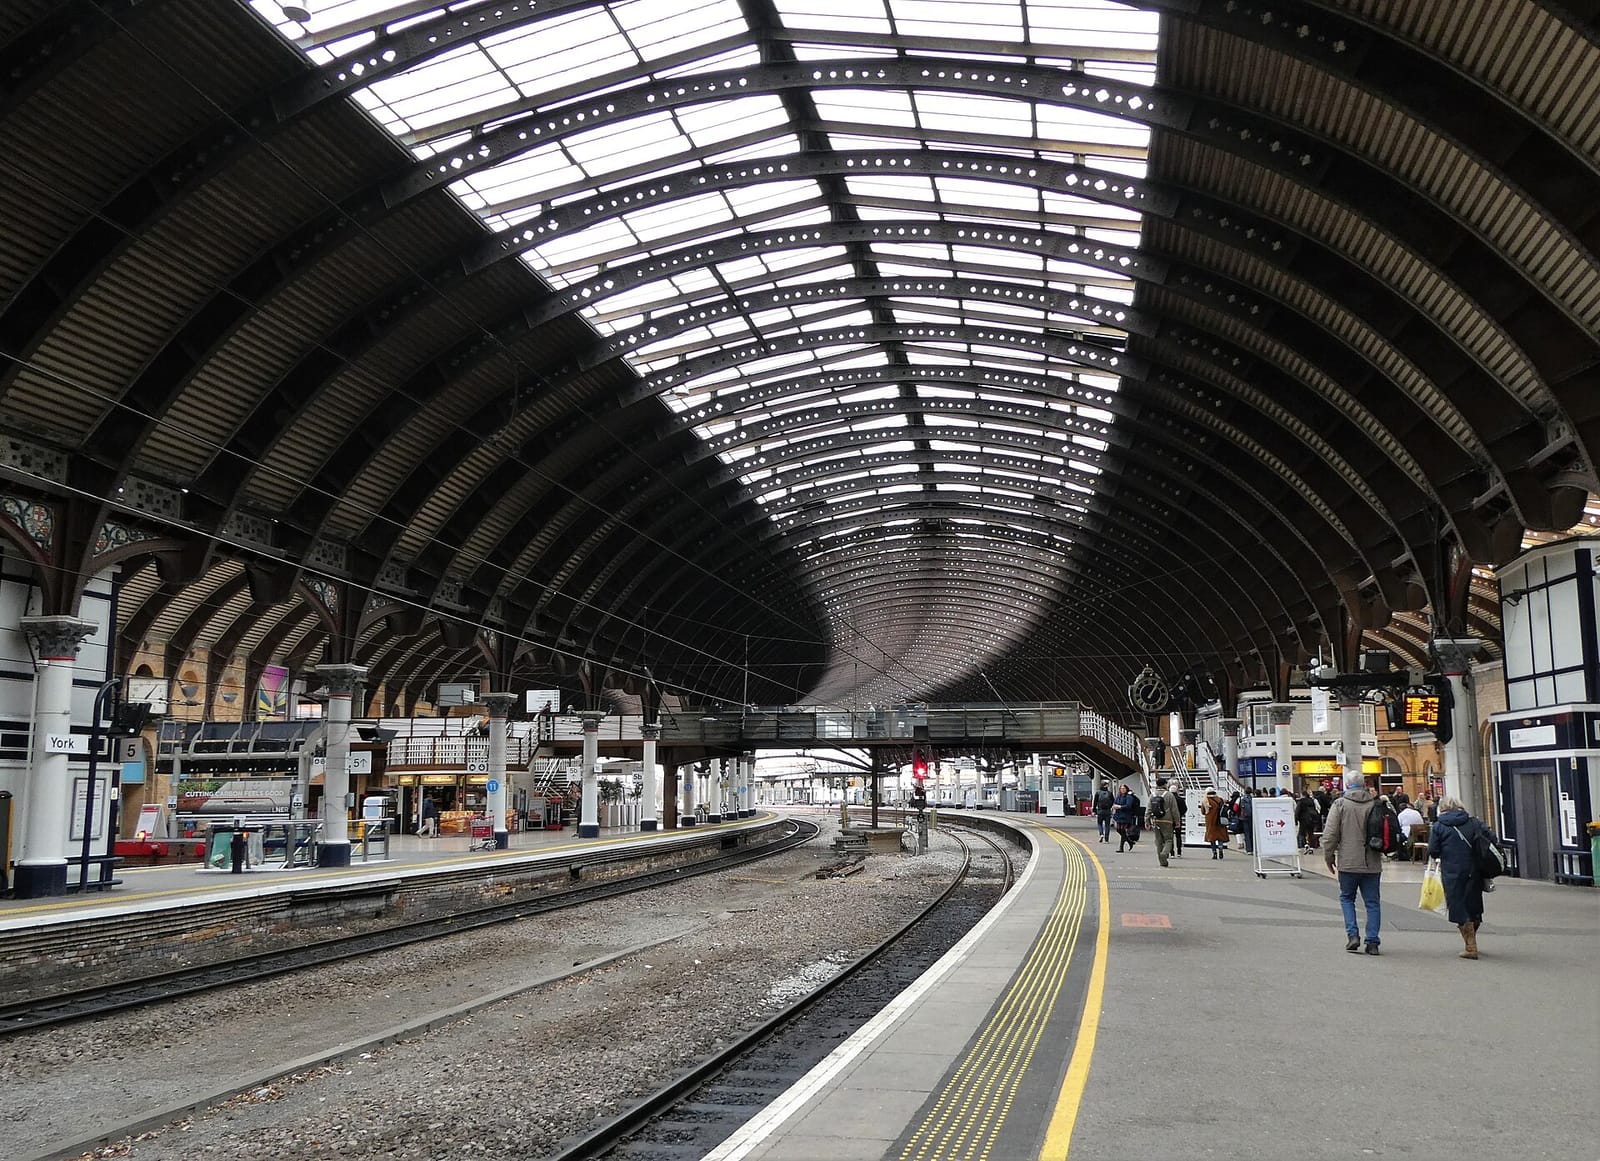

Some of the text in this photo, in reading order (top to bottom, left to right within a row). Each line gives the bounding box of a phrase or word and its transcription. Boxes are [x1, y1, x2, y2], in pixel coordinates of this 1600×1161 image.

[51, 737, 74, 748] York
[127, 744, 136, 757] 5
[353, 758, 360, 768] 5
[489, 783, 496, 791] 11
